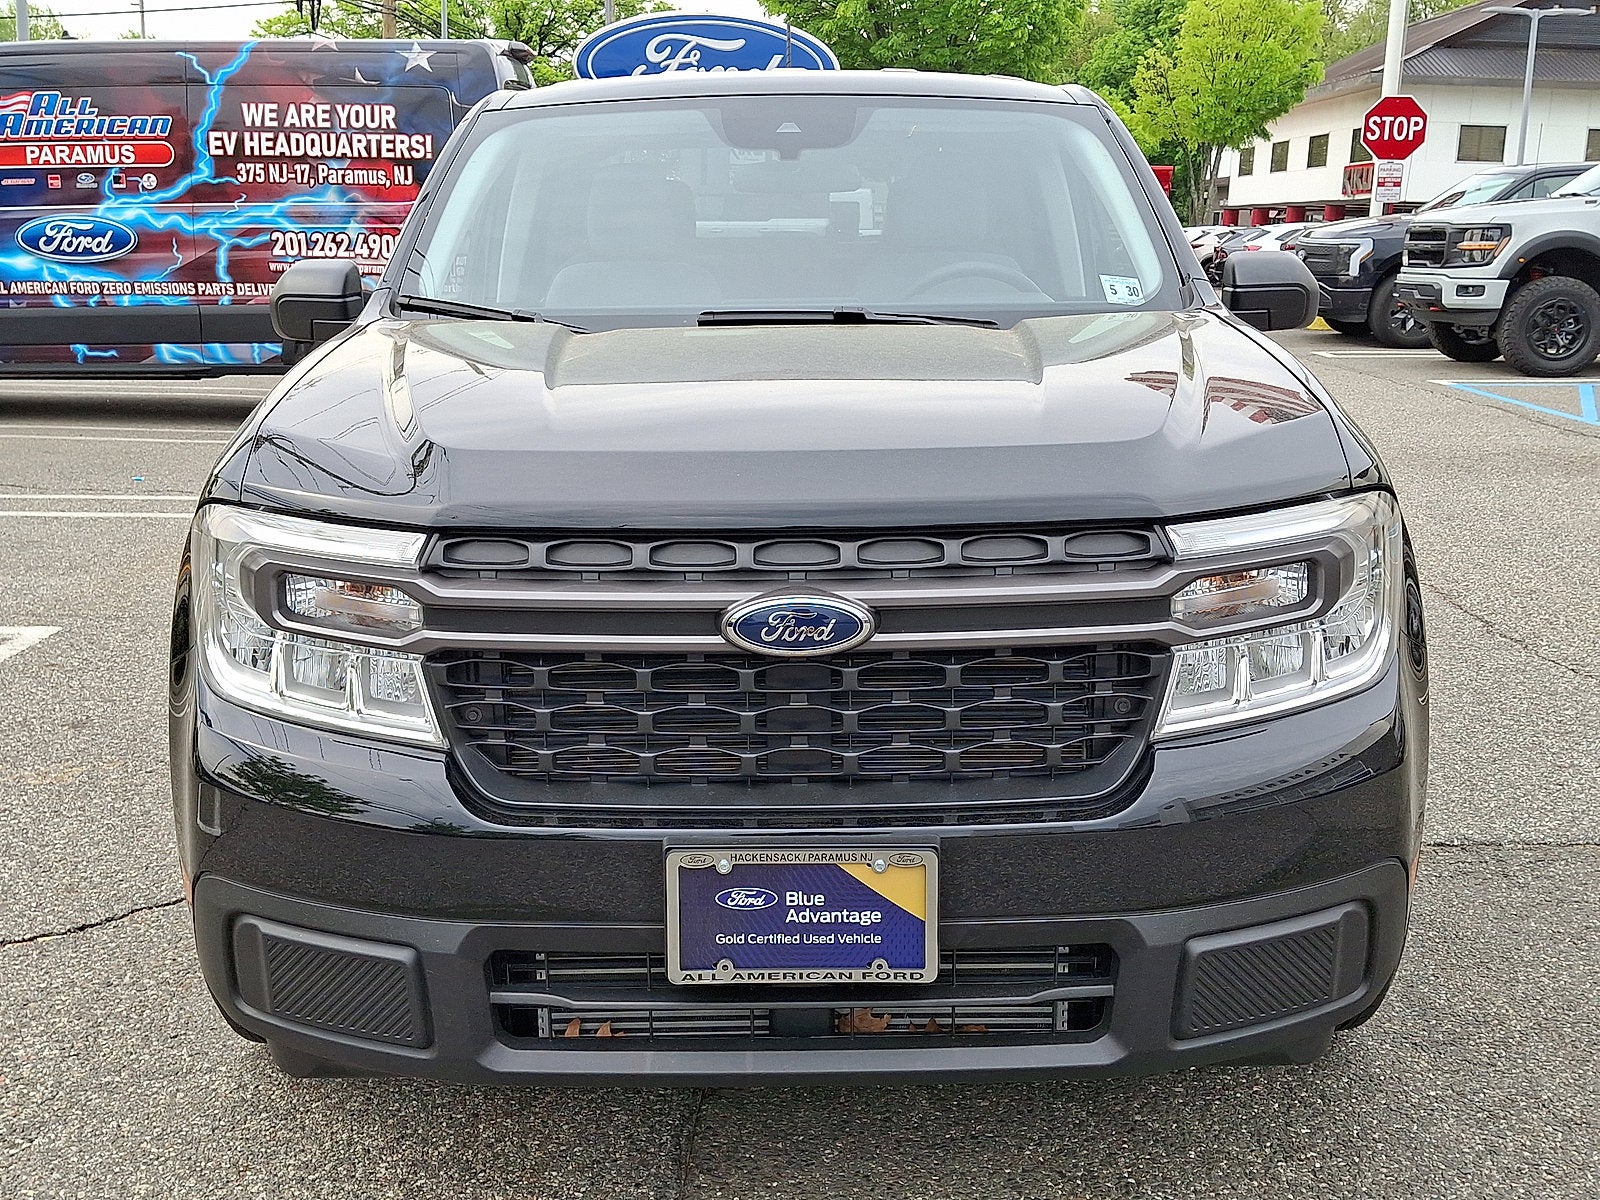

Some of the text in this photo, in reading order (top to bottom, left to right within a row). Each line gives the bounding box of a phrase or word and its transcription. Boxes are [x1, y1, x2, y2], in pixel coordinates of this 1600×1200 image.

[28, 91, 99, 117] ALL
[0, 113, 173, 136] AMERICAN
[241, 102, 397, 129] WE ARE YOUR
[1366, 115, 1424, 141] STOP
[208, 131, 433, 159] EV HEADQUARTERS!
[25, 145, 136, 164] PARAMUS
[236, 163, 414, 188] 375 NJ-17, Paramus, NJ
[38, 221, 114, 253] Ford
[270, 231, 400, 259] 201.262.490
[10, 282, 68, 294] AMERICAN
[70, 282, 100, 295] FORD
[102, 282, 132, 295] ZERO
[134, 283, 195, 295] EMISSIONS
[199, 283, 235, 296] PARTS
[1110, 284, 1140, 297] 5 30
[760, 611, 836, 642] Ford
[687, 855, 708, 864] Ford
[861, 852, 873, 862] NJ
[895, 855, 916, 864] Ford
[727, 890, 766, 906] Ford
[785, 891, 825, 906] Blue
[785, 908, 882, 926] Advantage
[715, 933, 882, 944] Gold Certified Used Vehicle
[681, 971, 925, 981] ALL AMERICAN FORD
